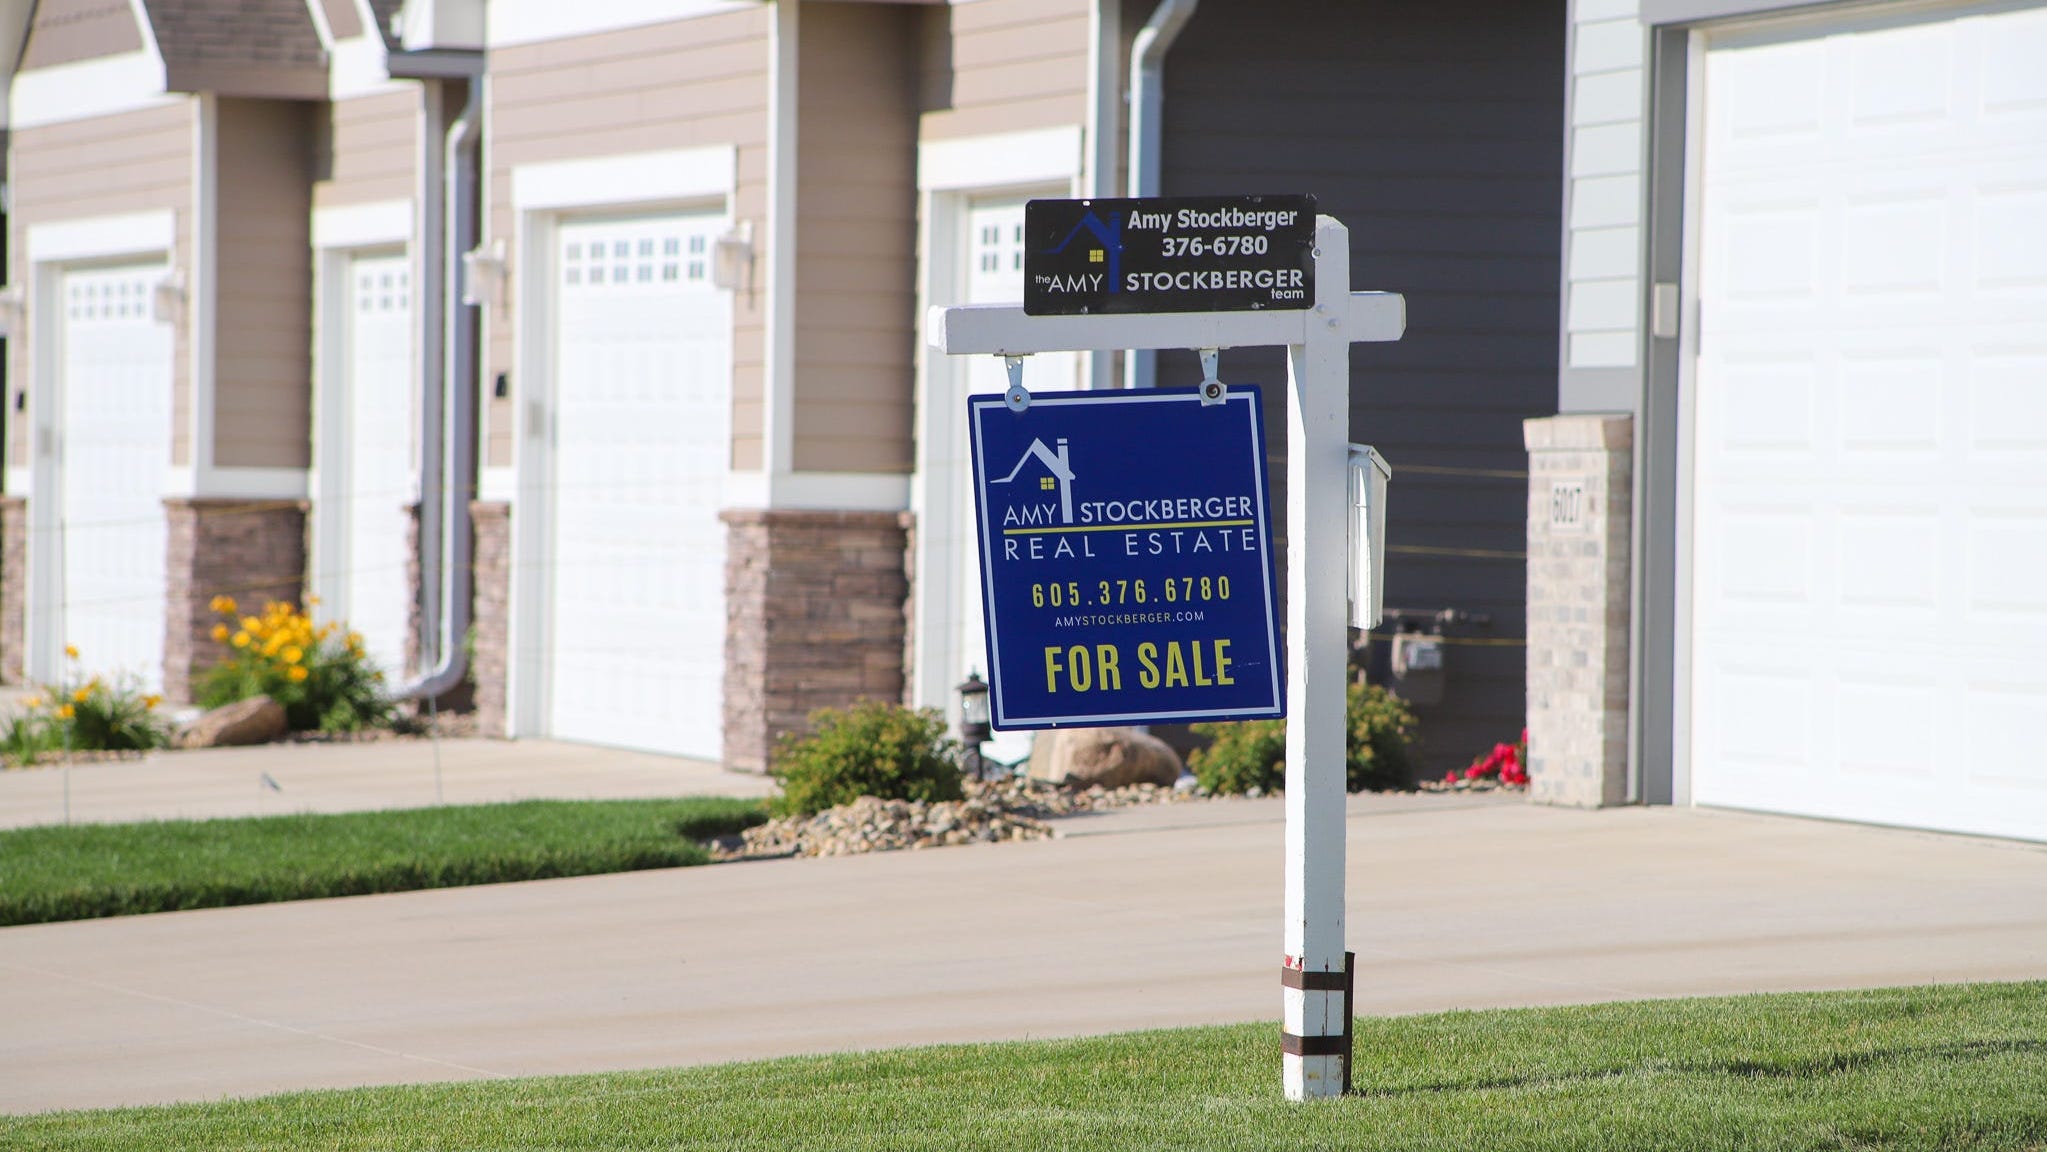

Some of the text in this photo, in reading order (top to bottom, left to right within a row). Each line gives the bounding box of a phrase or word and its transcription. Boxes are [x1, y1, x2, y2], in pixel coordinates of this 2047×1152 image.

[1127, 207, 1298, 233] Amy Stockberger
[1162, 235, 1268, 257] 376-6780
[1035, 269, 1304, 293] the AMY STOCKBERGER
[1271, 288, 1304, 300] team
[1003, 496, 1254, 527] AMY STOCKBERGER
[1552, 485, 1582, 523] 6017
[1004, 529, 1256, 561] REAL ESTATE
[1032, 575, 1231, 608] 605.376.6780
[1055, 611, 1205, 627] AMYSTOCKBERGER.COM
[1045, 638, 1235, 693] FOR SALE
